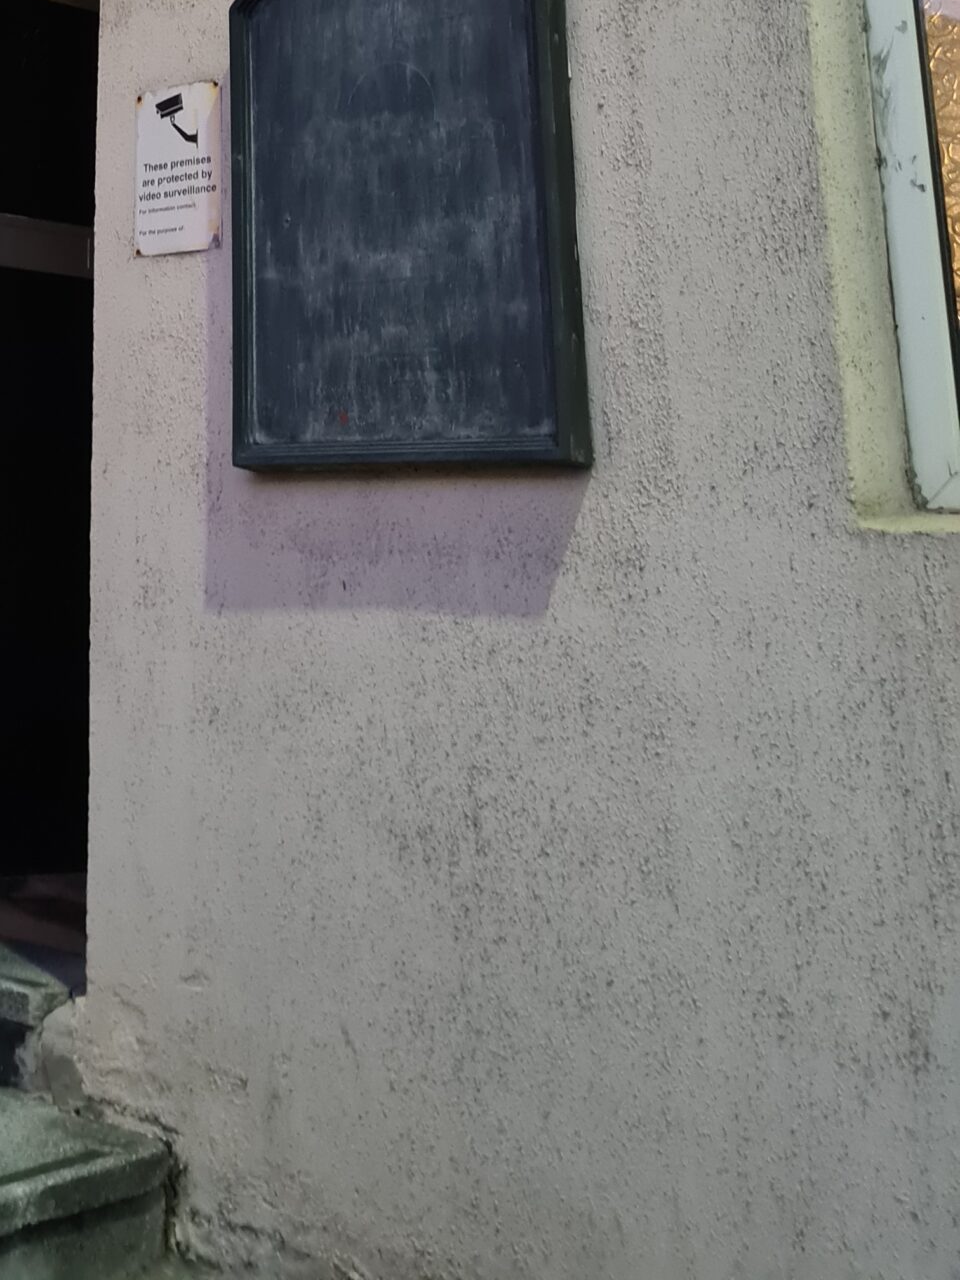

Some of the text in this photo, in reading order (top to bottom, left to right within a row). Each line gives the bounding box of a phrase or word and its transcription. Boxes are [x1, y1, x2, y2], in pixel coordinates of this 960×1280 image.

[143, 155, 211, 173] These premises
[142, 169, 213, 188] are protected by
[138, 184, 217, 202] video surveillance
